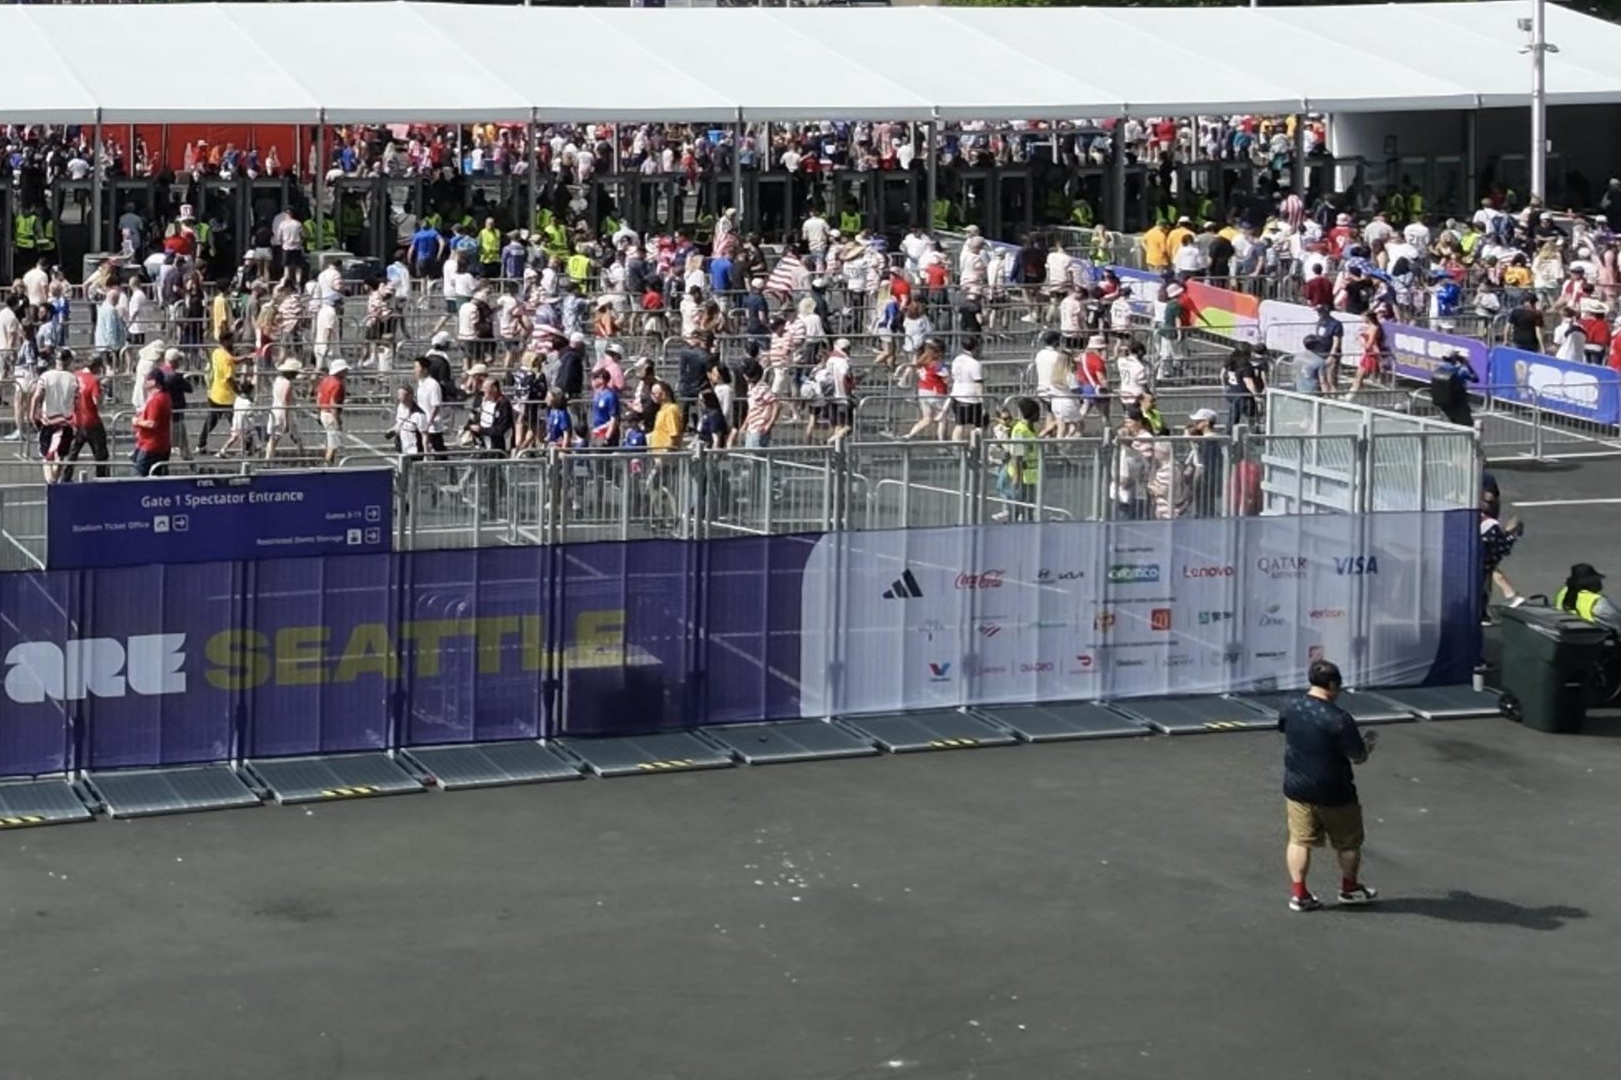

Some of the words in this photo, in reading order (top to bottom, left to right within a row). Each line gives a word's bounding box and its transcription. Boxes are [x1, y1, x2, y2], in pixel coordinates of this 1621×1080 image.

[141, 495, 172, 508] Gate
[175, 494, 181, 506] 1
[185, 492, 246, 508] Spectator
[248, 490, 304, 504] Entrance
[1183, 565, 1235, 579] Lenovo
[1257, 556, 1308, 573] QATAR
[1333, 556, 1378, 575] VISA
[203, 609, 626, 690] SEATTLE
